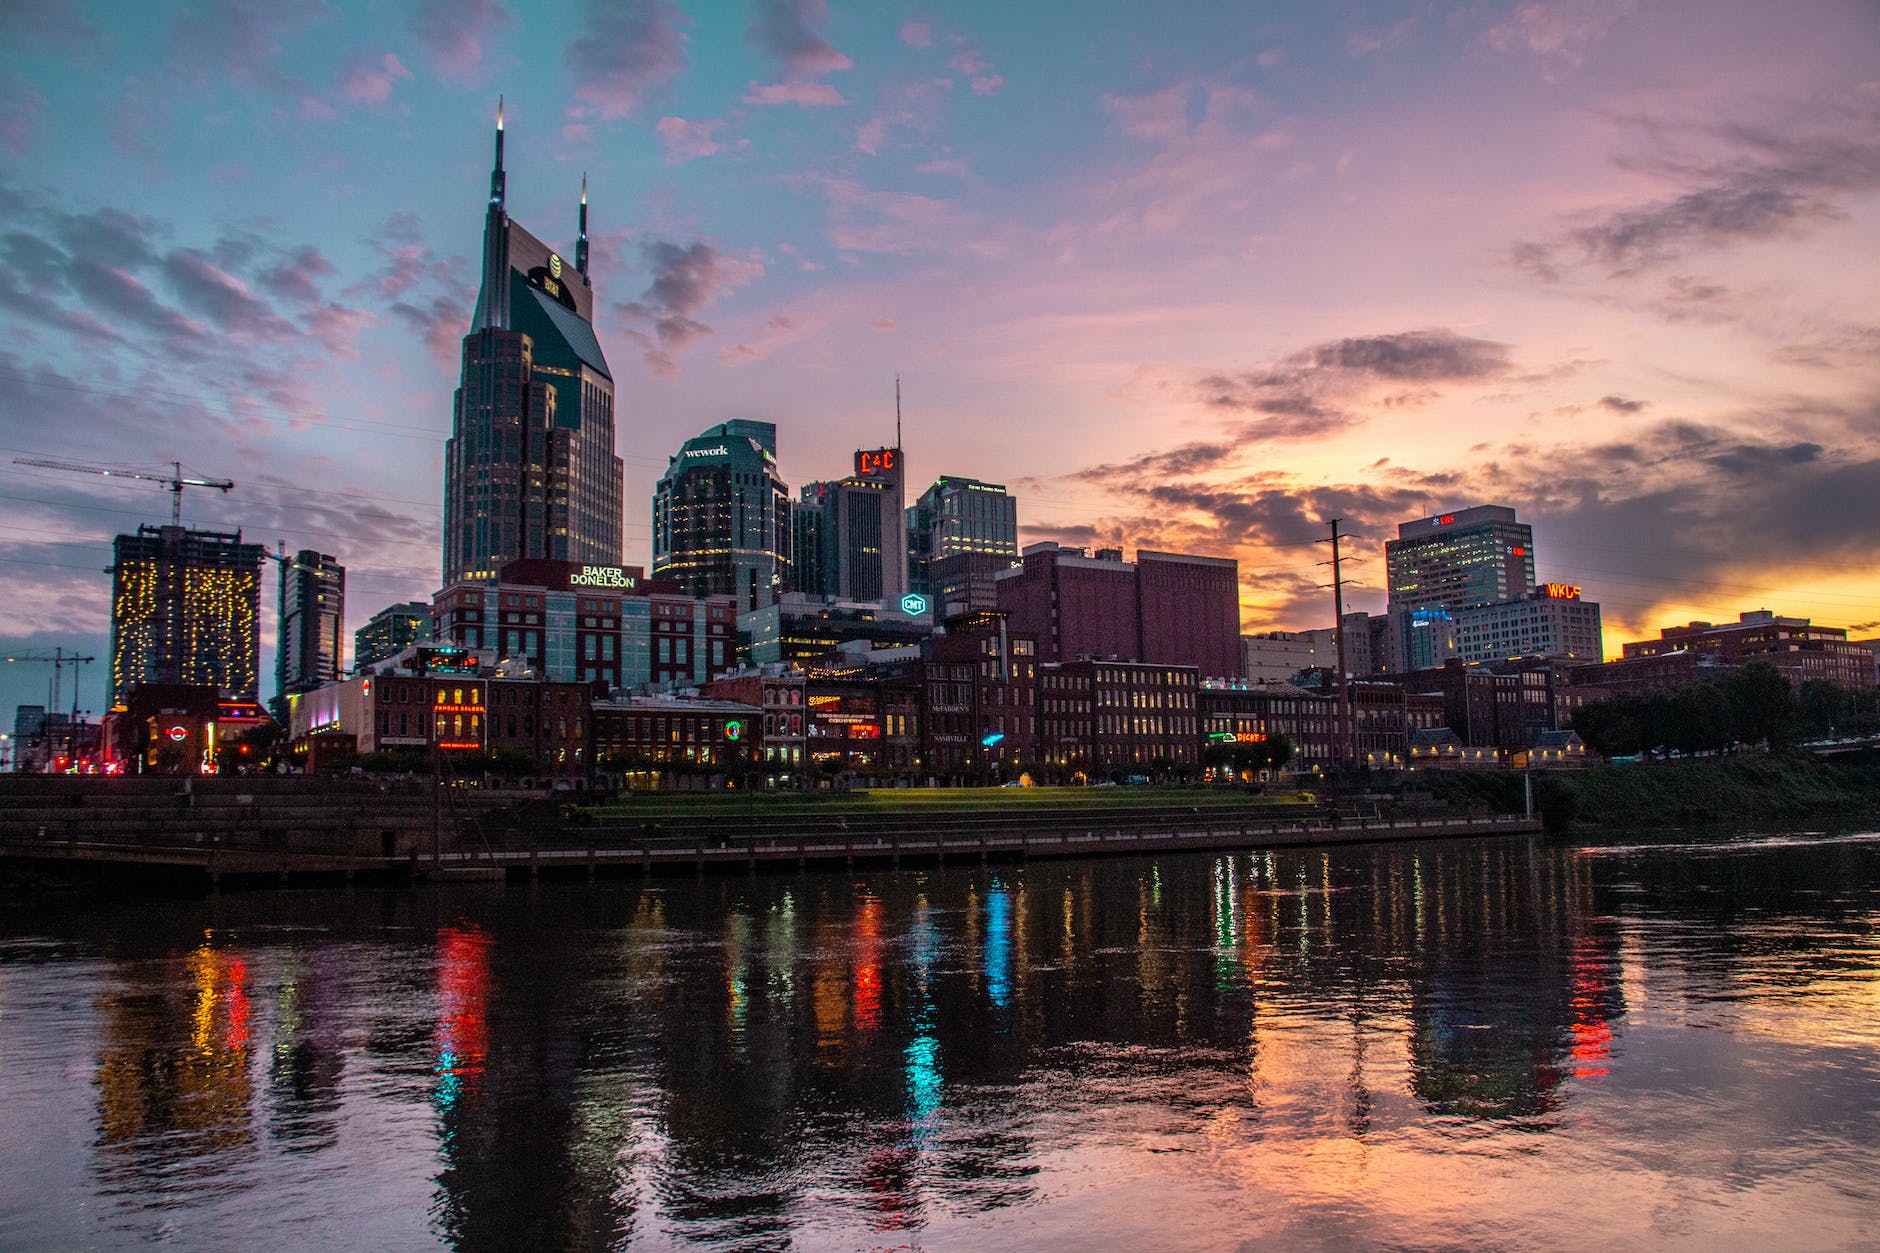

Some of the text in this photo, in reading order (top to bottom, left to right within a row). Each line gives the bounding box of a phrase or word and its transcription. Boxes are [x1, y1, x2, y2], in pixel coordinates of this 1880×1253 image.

[685, 445, 728, 457] wework
[583, 566, 621, 577] BAKER
[570, 574, 634, 588] DONELSON
[905, 600, 922, 609] CMT
